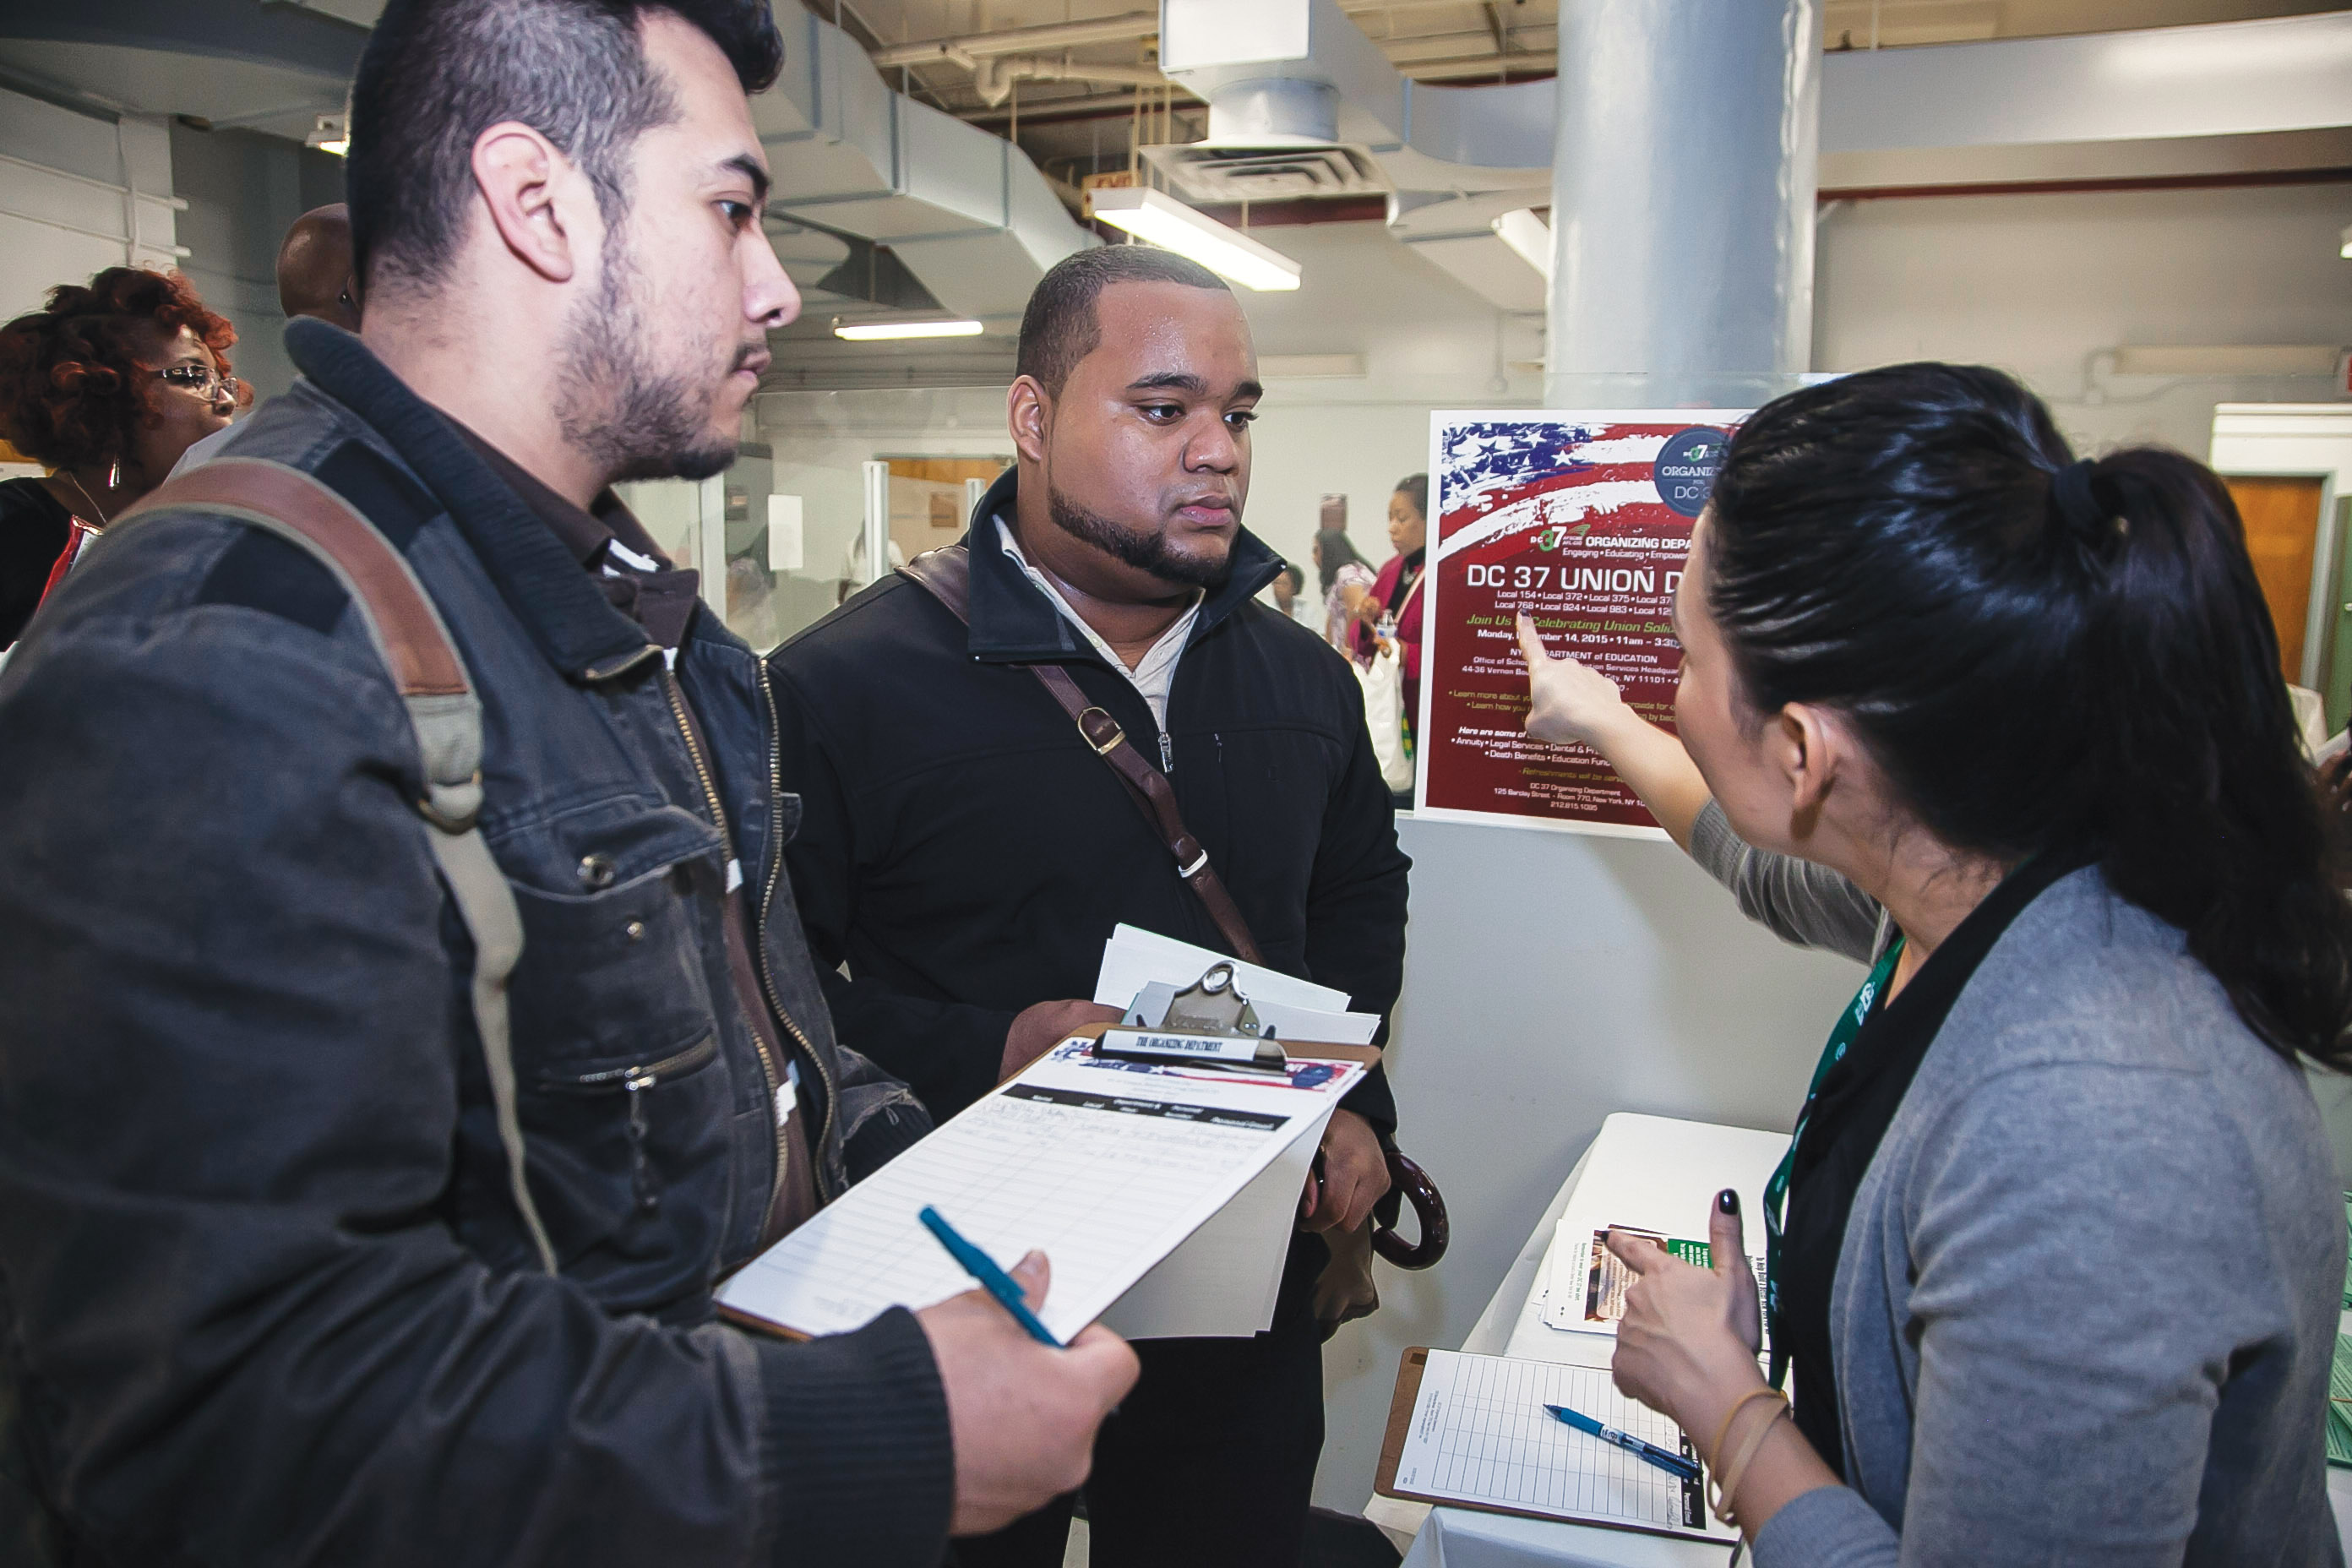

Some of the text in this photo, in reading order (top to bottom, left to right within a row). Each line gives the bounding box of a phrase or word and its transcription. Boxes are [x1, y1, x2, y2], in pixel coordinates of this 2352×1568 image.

[1662, 466, 1714, 476] ORGANIZ
[1674, 486, 1699, 499] DC
[1585, 536, 1692, 550] ORGANIZING DEPA
[1562, 548, 1689, 560] Engaging Educating Empower
[1467, 564, 1505, 587] DC
[1514, 566, 1550, 589] 37
[1560, 567, 1655, 593] UNION
[1543, 591, 1563, 600] Local
[1612, 594, 1630, 602] 375
[1636, 595, 1658, 603] Local
[1540, 602, 1561, 611] Local
[1563, 603, 1580, 612] 924
[1587, 604, 1608, 612] Local
[1658, 607, 1672, 616] 12
[1467, 614, 1492, 624] Join
[1495, 615, 1512, 625] Us
[1604, 620, 1641, 632] Union
[1582, 634, 1609, 644] 2015
[1616, 636, 1643, 645] 11am
[1546, 651, 1592, 660] PARTMENT
[1605, 653, 1658, 663] EDUCATION
[1606, 664, 1639, 672] Services
[1641, 666, 1679, 675] Headquar
[1458, 727, 1478, 735] Here
[1518, 730, 1527, 738] of
[1456, 737, 1484, 748] Annuity
[1489, 739, 1510, 749] Legal
[1511, 740, 1544, 750] Services
[1550, 743, 1576, 753] Dental
[1490, 749, 1512, 759] Death
[1515, 752, 1546, 761] Benefits
[1552, 754, 1590, 765] Education
